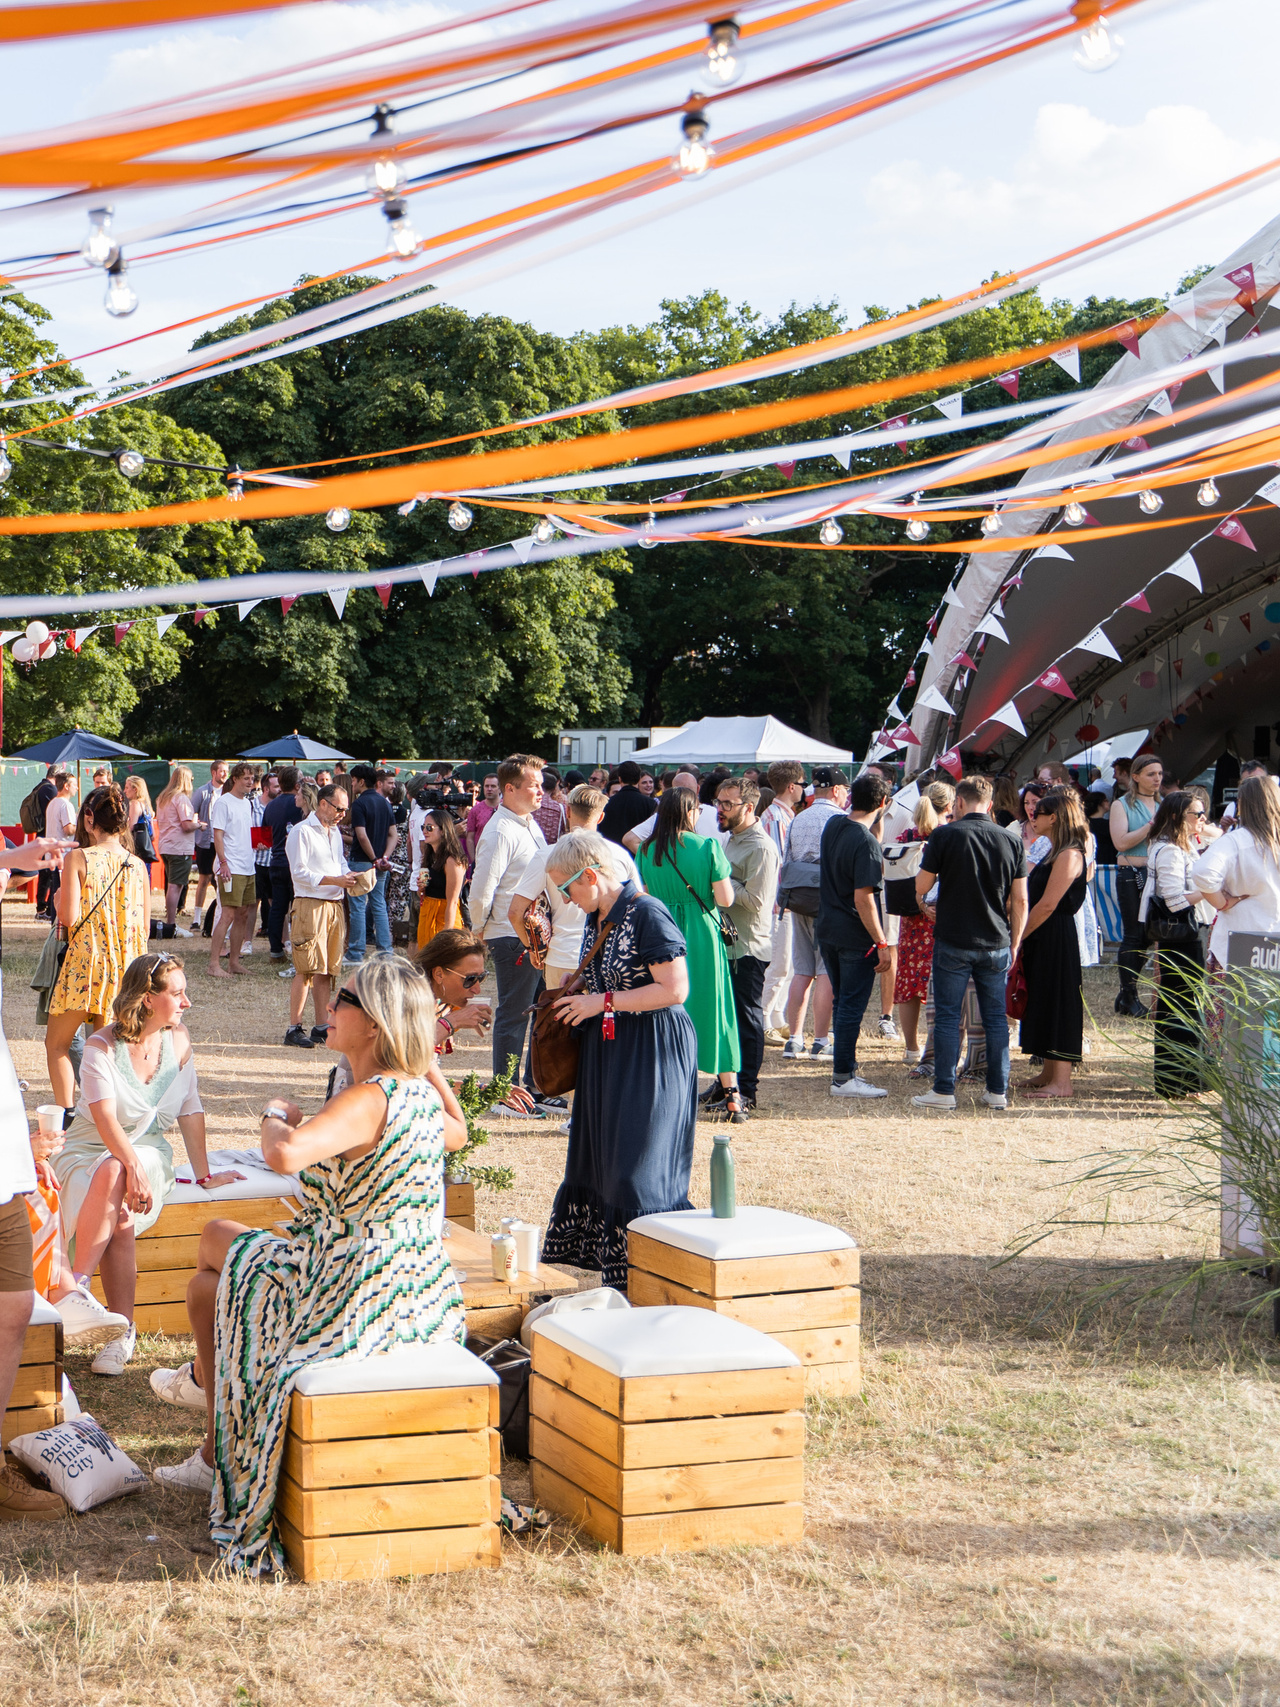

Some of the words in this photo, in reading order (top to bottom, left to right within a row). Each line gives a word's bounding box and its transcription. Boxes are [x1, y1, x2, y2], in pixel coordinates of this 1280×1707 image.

[35, 1427, 62, 1443] We
[40, 1432, 75, 1465] Built
[53, 1442, 85, 1469] This
[66, 1453, 94, 1479] City
